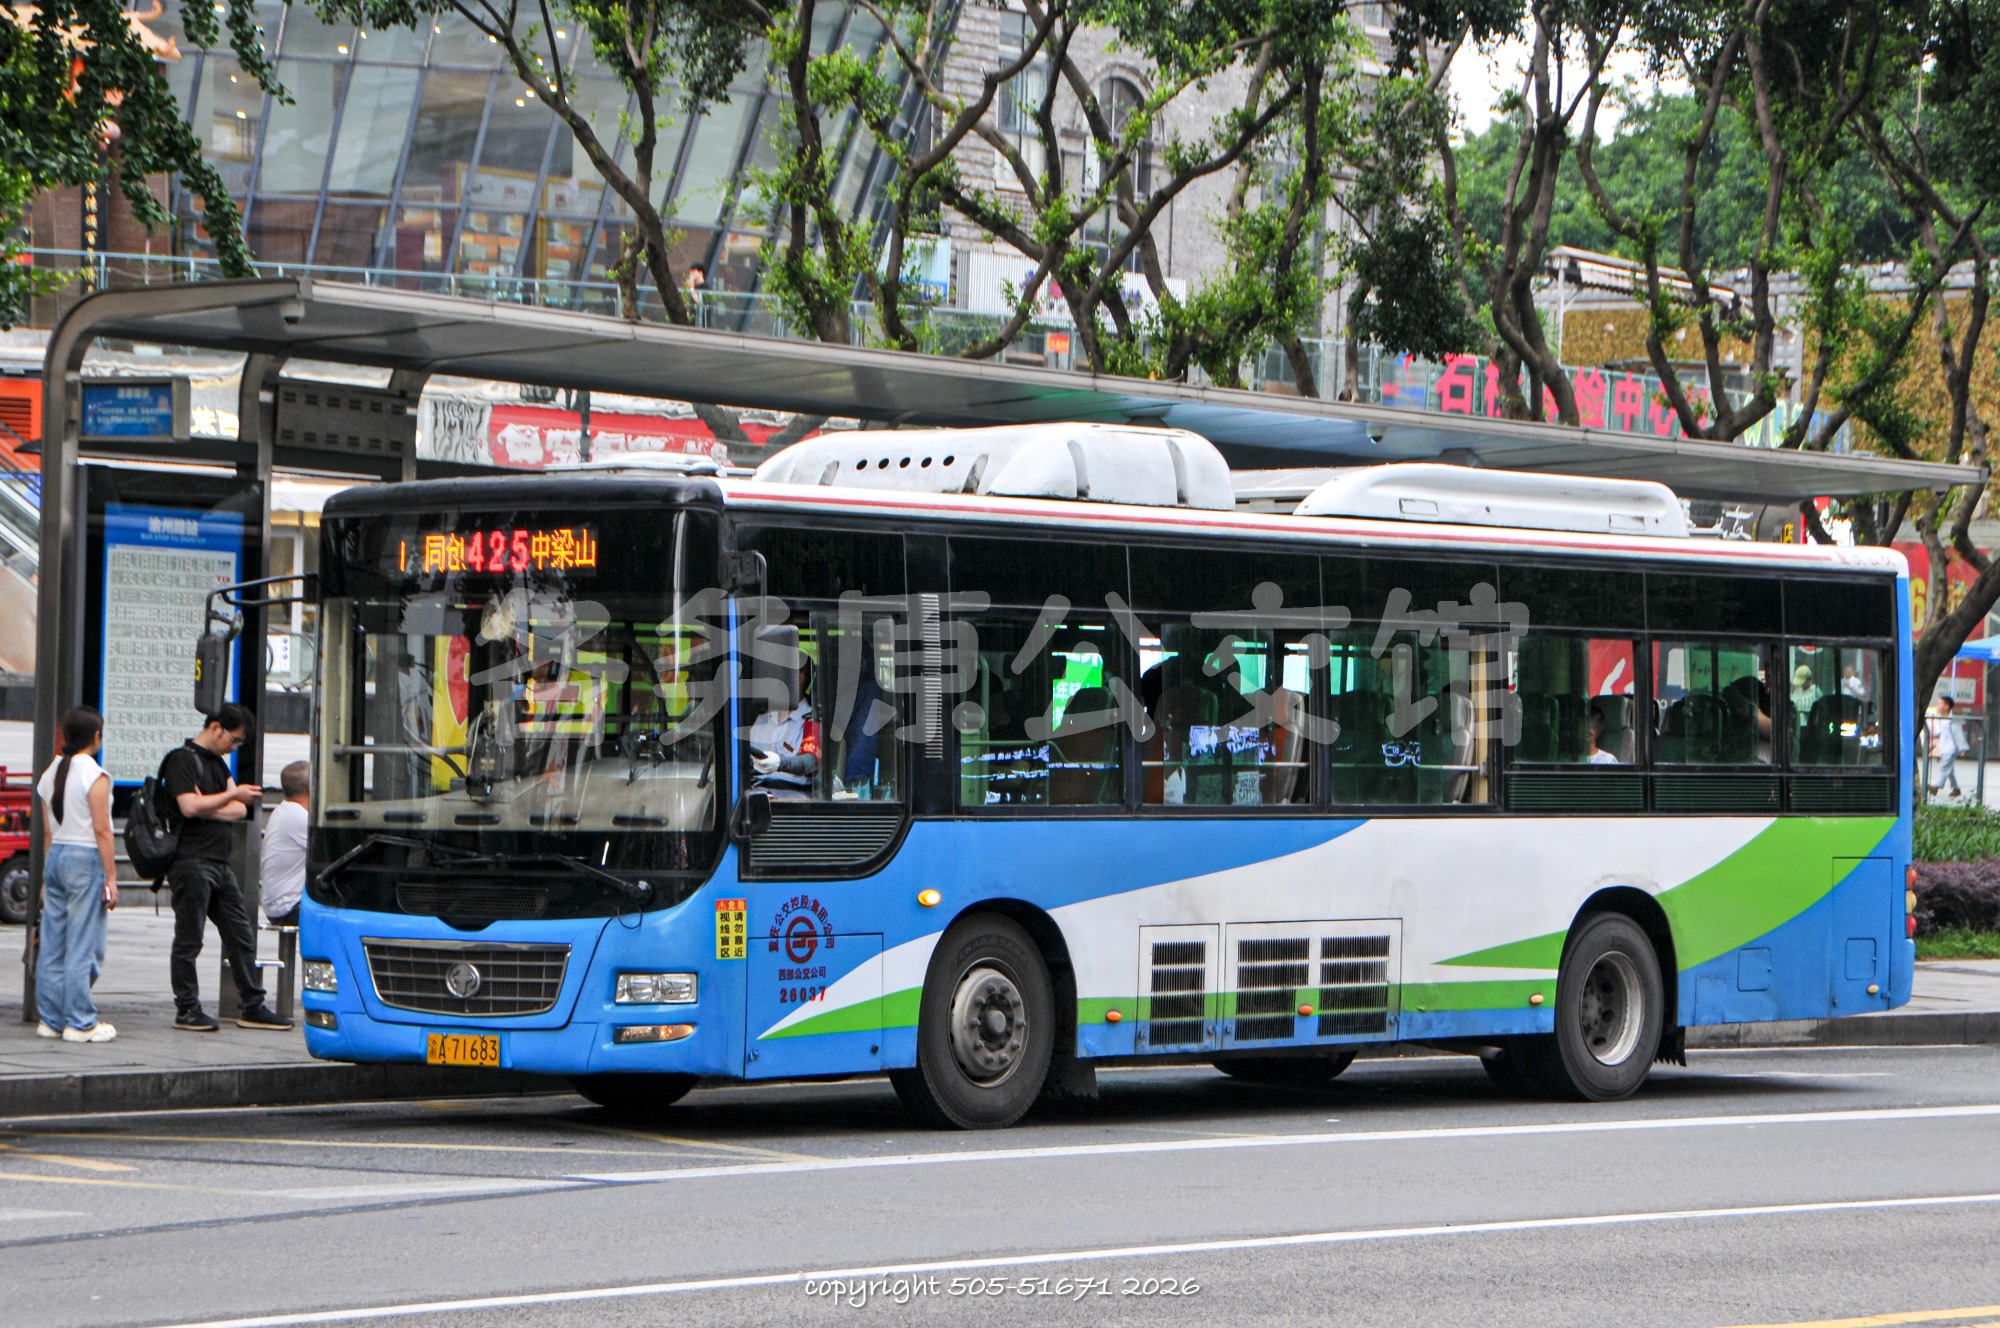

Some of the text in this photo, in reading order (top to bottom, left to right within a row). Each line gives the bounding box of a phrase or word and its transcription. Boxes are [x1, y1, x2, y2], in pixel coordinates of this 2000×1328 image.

[467, 529, 530, 573] 425
[531, 528, 596, 571] 中梁山
[728, 901, 745, 910] 危险
[778, 966, 827, 981] 西部公交公司
[780, 985, 827, 1003] 26037
